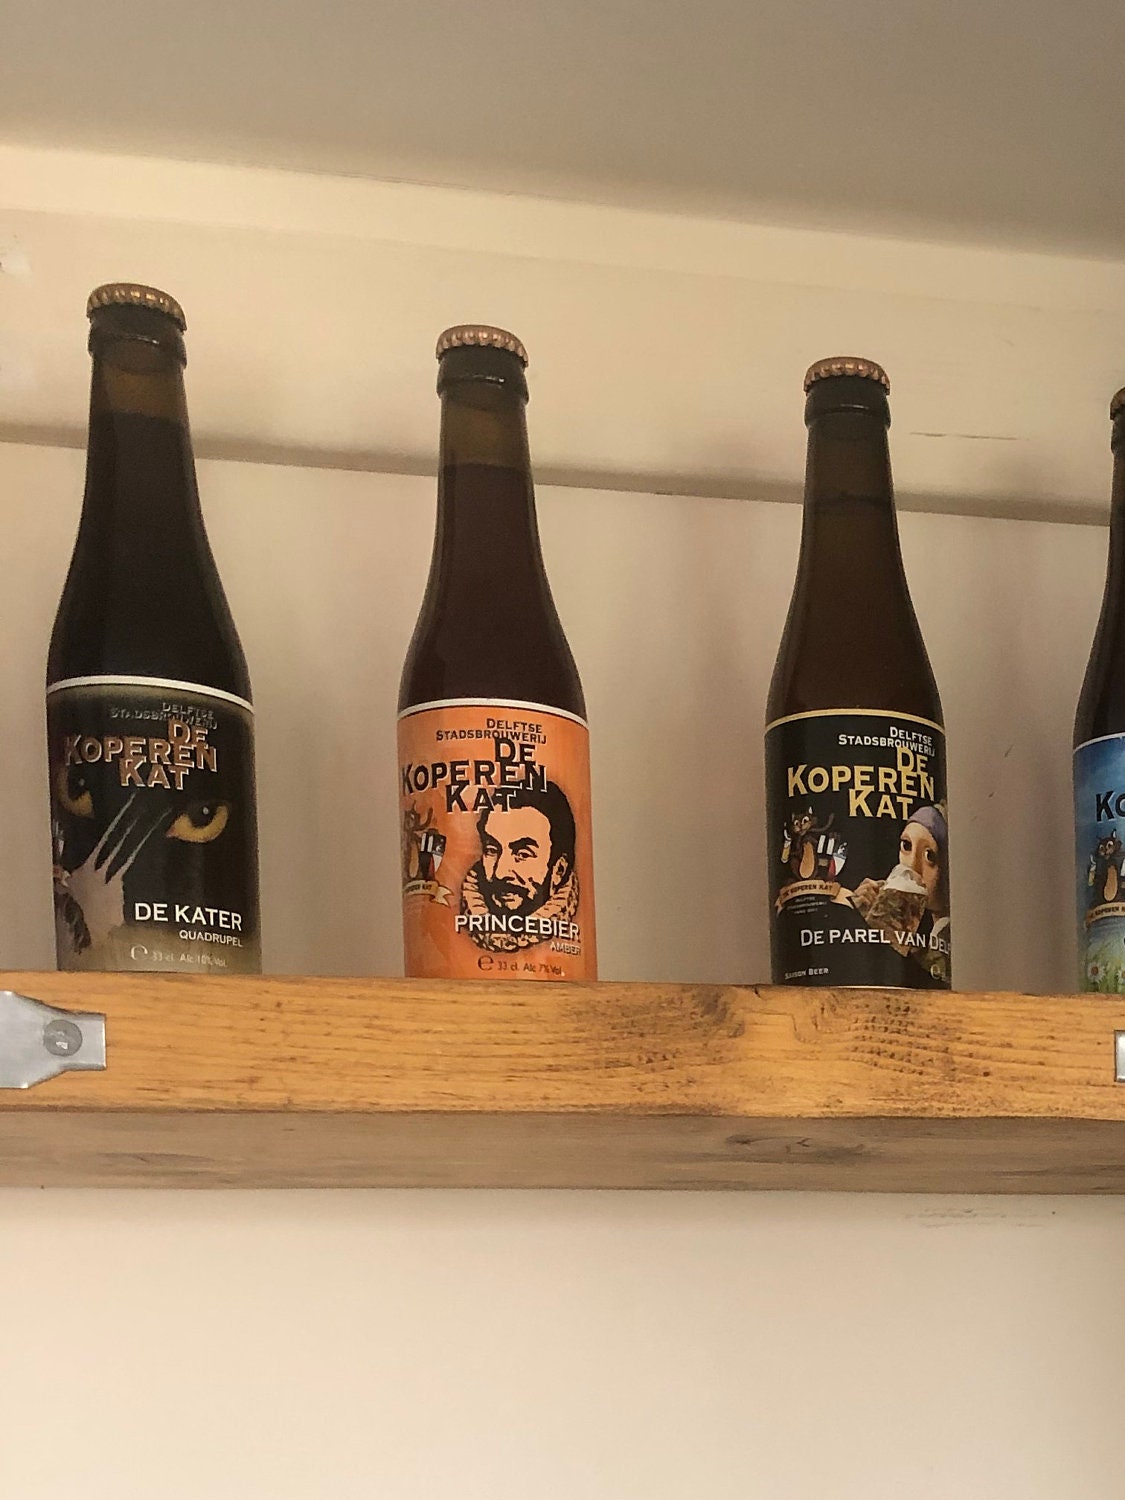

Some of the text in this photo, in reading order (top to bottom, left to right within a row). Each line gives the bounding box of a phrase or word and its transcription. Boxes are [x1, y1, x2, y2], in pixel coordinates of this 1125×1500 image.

[168, 717, 209, 749] DE
[436, 729, 547, 745] STADSBROUWERIJ
[486, 718, 543, 734] DELFTSE
[890, 726, 933, 746] DELFTSE
[64, 733, 217, 772] KOPEREN
[494, 738, 536, 766] DE
[838, 734, 935, 757] STADSBROUWERIJ
[119, 757, 190, 790] KAT
[897, 747, 929, 777] DE
[402, 759, 548, 795] KOPEREN
[787, 763, 935, 802] KOPEREN
[445, 780, 518, 814] KAT
[848, 786, 914, 821] KAT
[135, 902, 243, 931] DE KATER
[454, 914, 582, 942] PRINCEBIER
[179, 929, 244, 948] QUADRUPEL
[549, 941, 581, 956] AMBER
[800, 929, 825, 947] DE
[829, 929, 890, 945] PAREL
[894, 930, 926, 948] VAN
[808, 967, 829, 976] BEER
